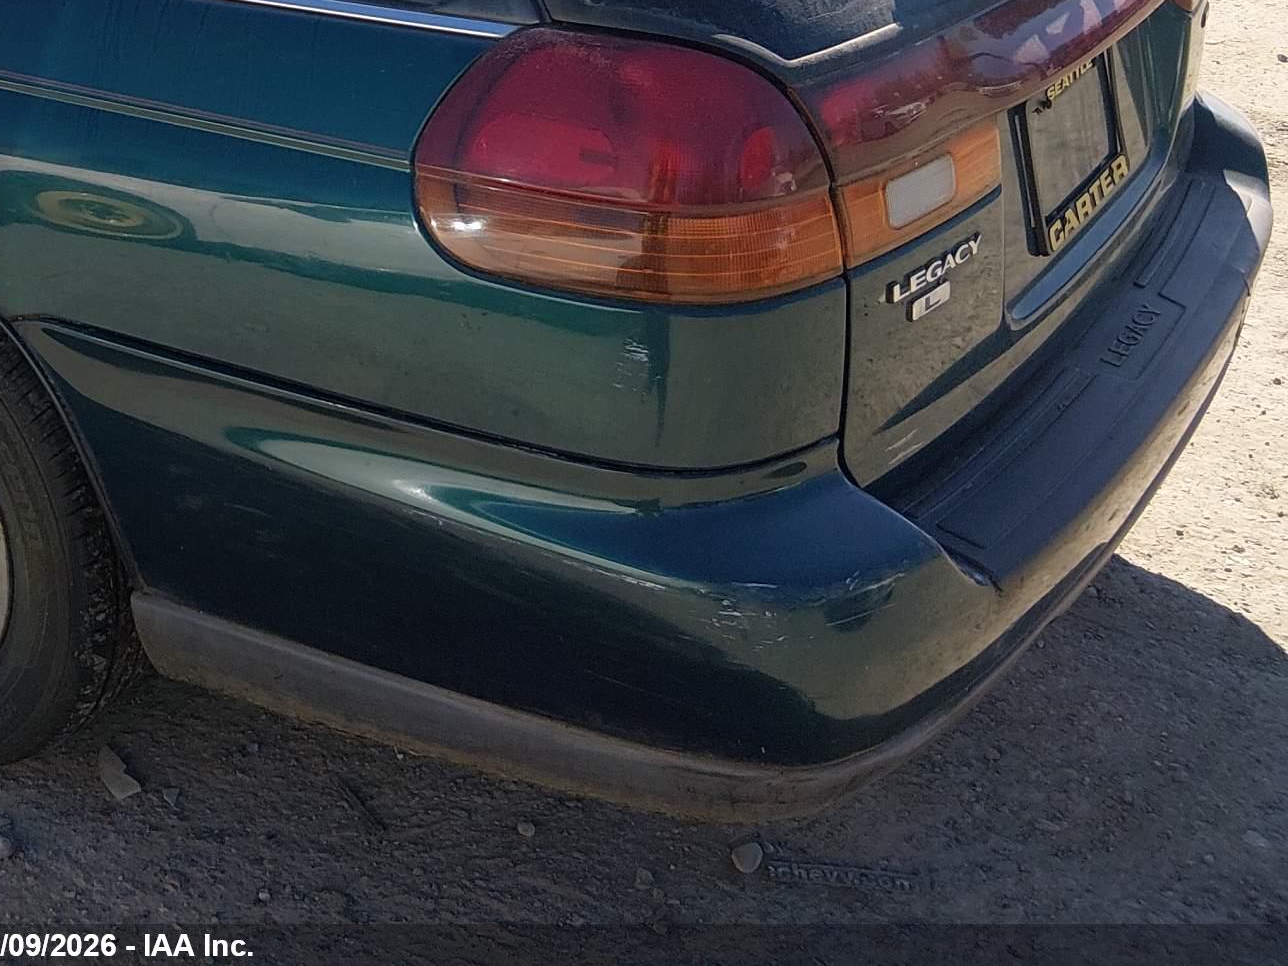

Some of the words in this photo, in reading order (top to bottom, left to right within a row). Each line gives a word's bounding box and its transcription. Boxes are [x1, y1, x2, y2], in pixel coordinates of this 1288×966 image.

[1046, 58, 1093, 101] SEATTLE
[1048, 154, 1130, 251] CARTER
[887, 231, 983, 303] LEGACY
[1099, 303, 1161, 368] LEGACY
